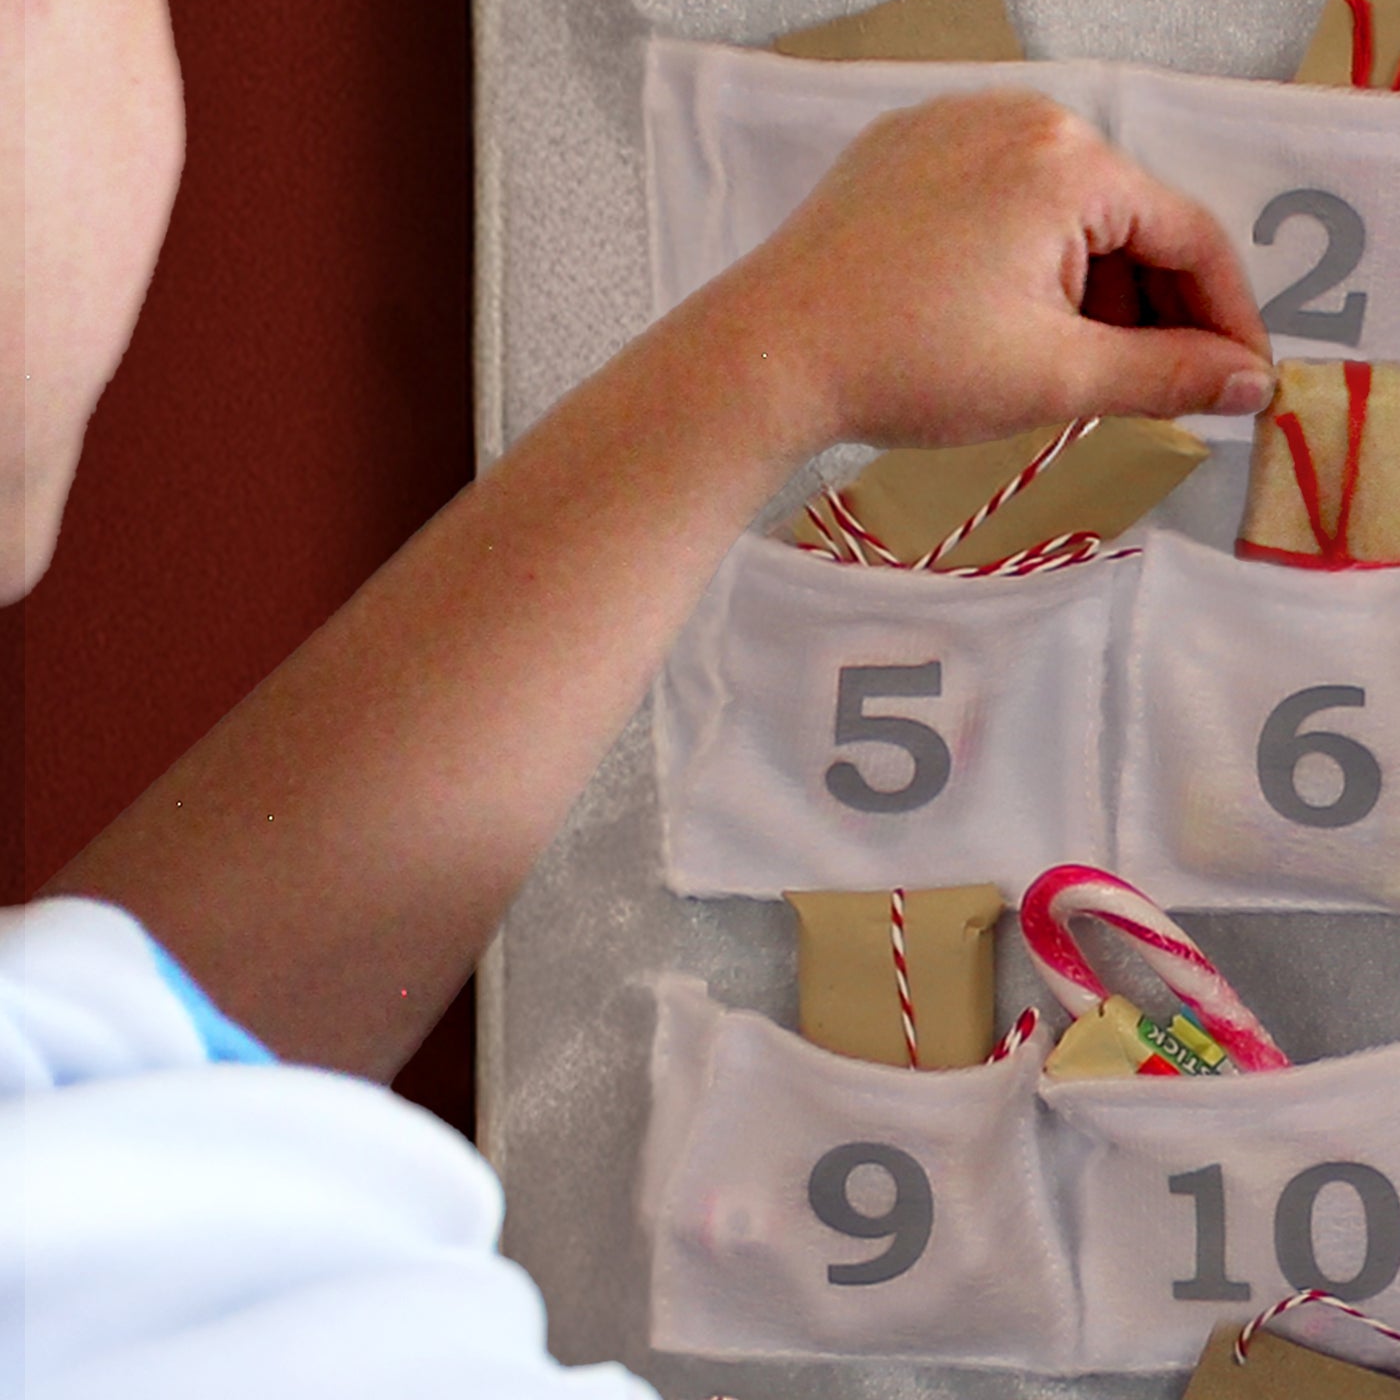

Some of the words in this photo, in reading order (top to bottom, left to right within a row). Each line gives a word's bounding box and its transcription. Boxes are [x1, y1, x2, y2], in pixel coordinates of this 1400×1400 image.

[1252, 188, 1367, 346] 2
[825, 661, 952, 814] 5
[1257, 685, 1382, 828] 6
[807, 1142, 934, 1286] 9
